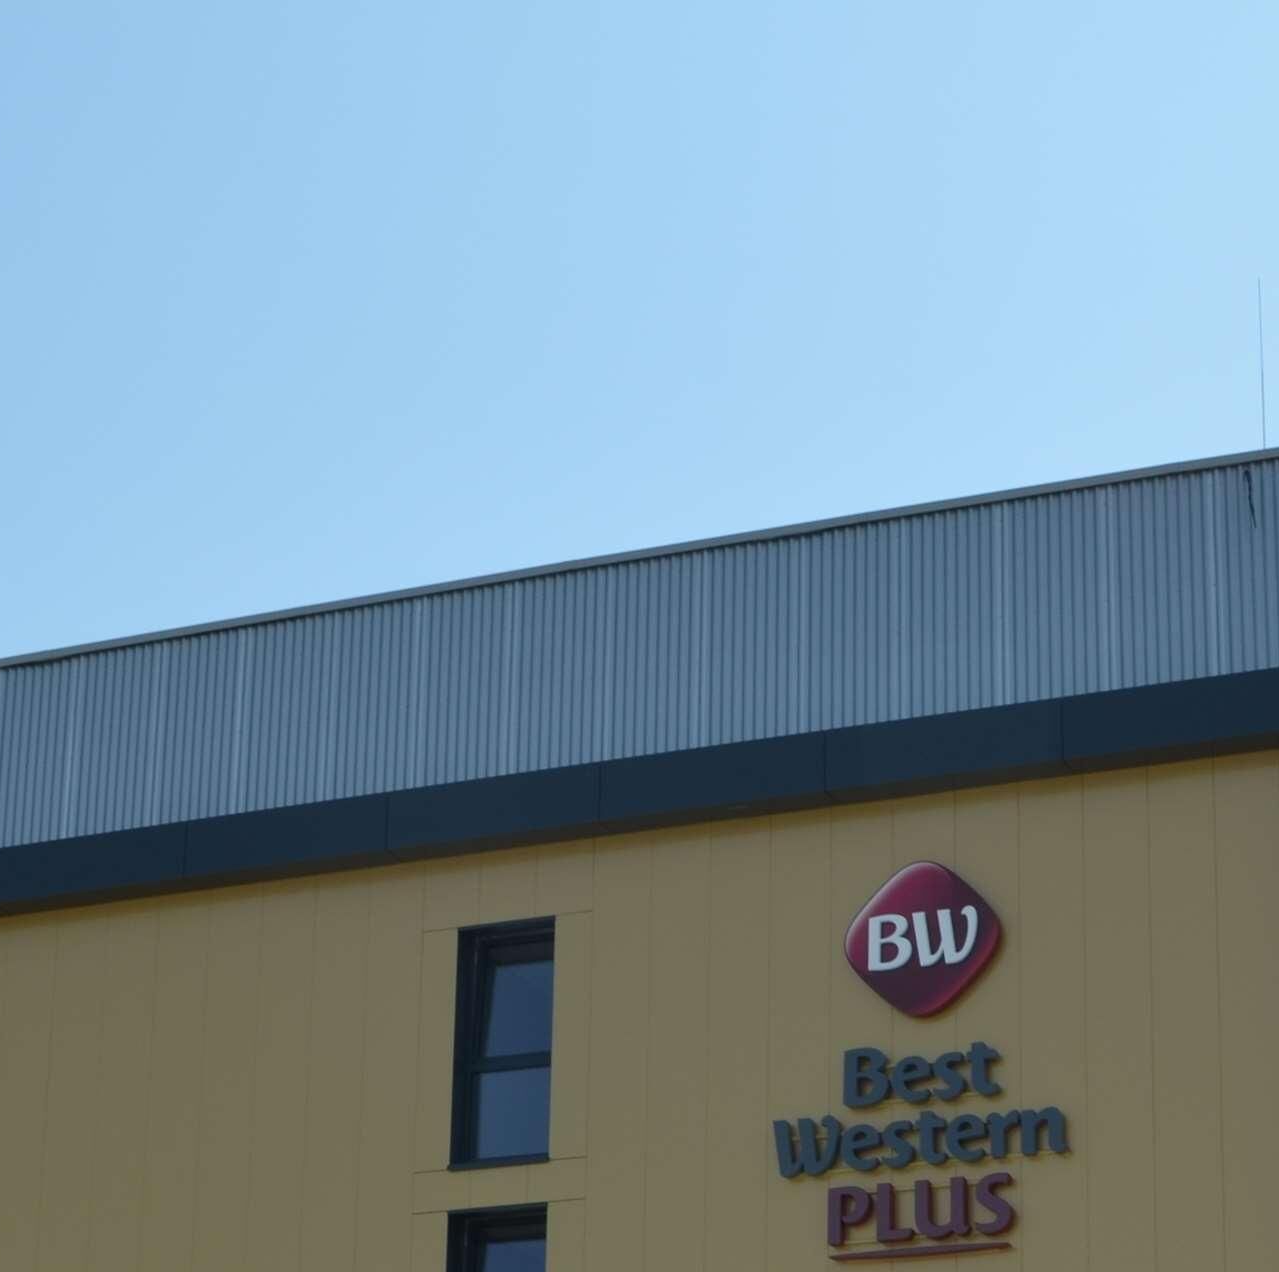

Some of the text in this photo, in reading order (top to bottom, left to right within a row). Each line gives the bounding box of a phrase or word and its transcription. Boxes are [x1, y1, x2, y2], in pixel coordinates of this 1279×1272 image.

[867, 905, 978, 971] BW
[842, 1041, 1002, 1109] Best
[772, 1106, 1070, 1179] Western
[827, 1172, 1016, 1246] PLUS
